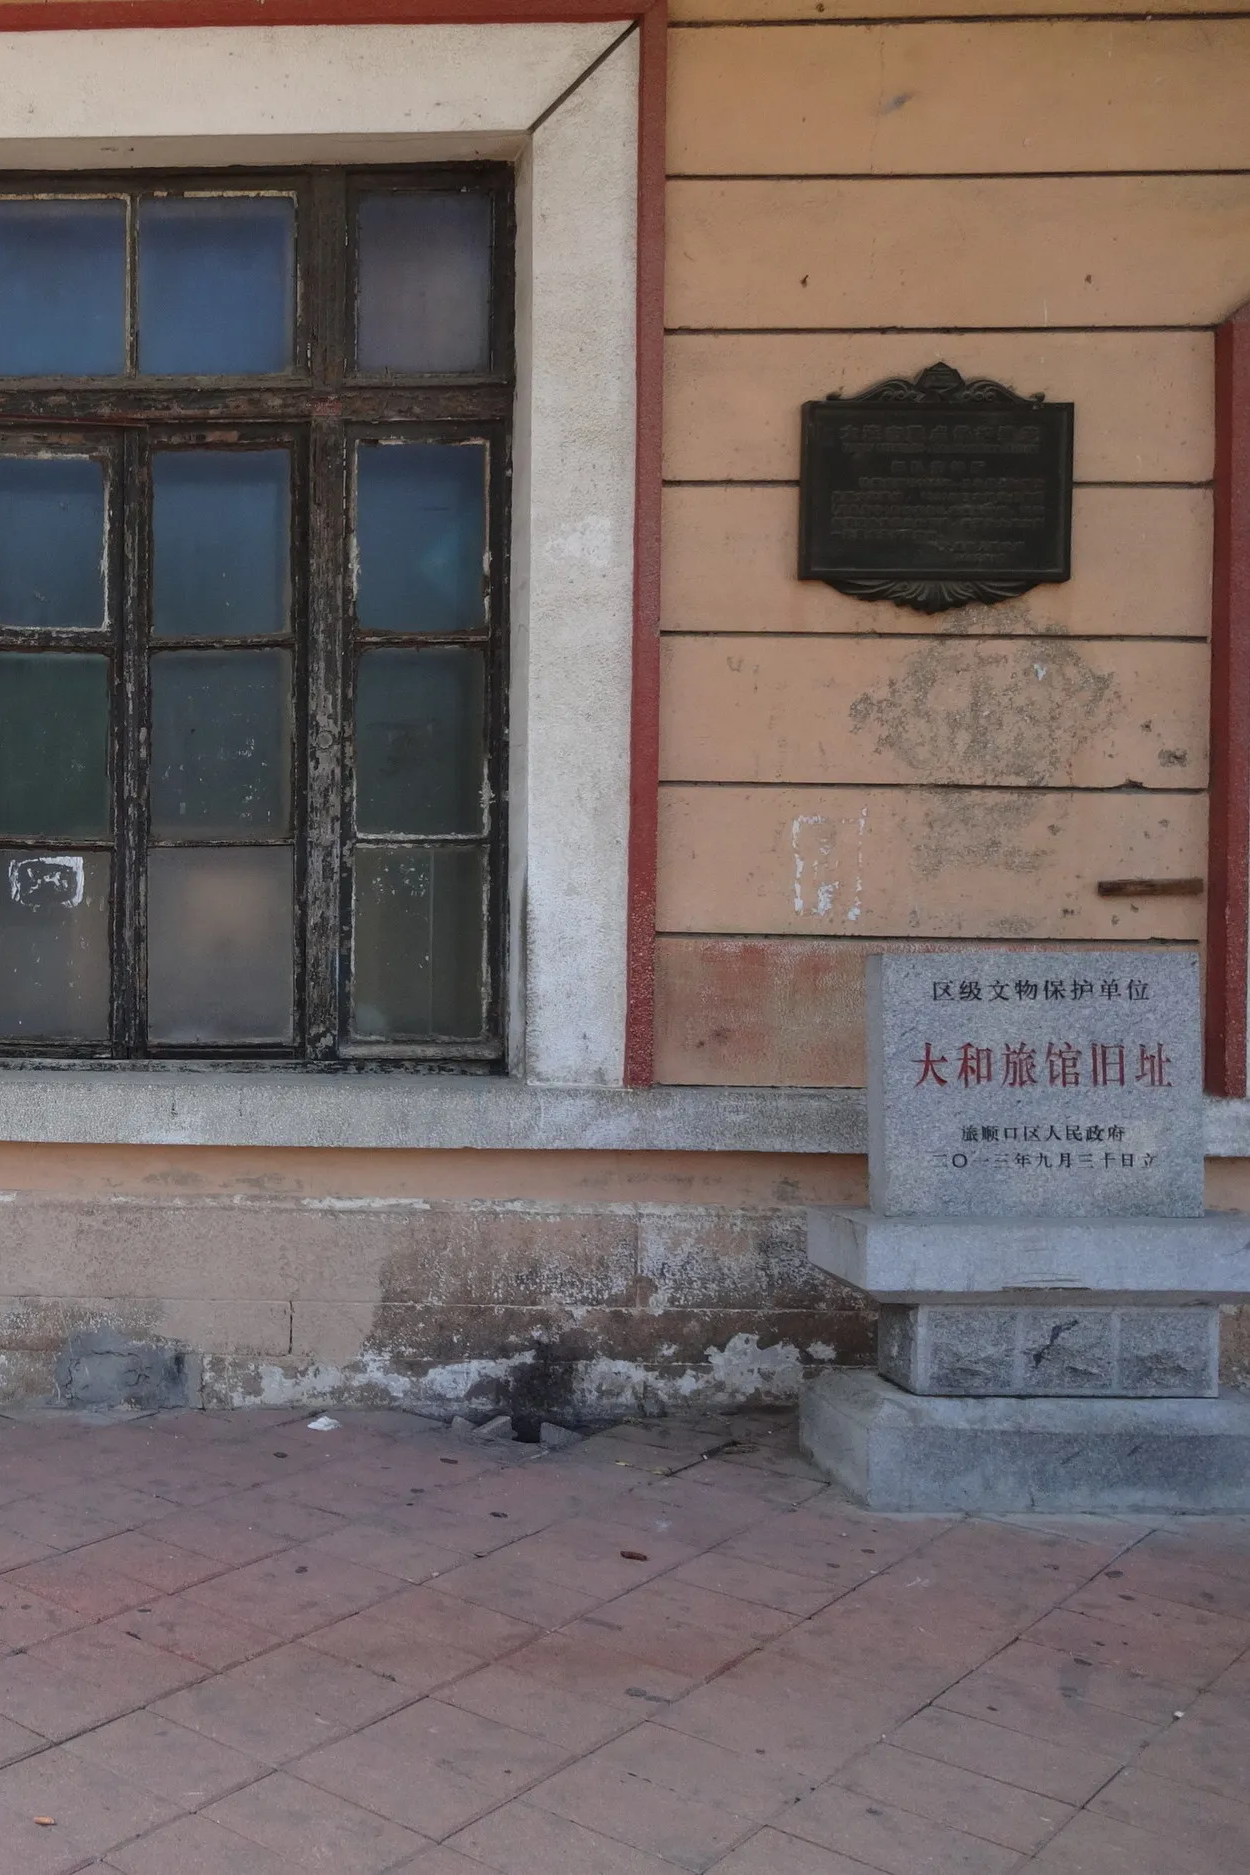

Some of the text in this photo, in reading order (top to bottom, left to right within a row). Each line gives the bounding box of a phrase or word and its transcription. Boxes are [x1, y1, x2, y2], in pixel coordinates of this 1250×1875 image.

[932, 979, 1150, 1002] 区级文物保护单位
[911, 1041, 1174, 1089] 大和旅馆旧址
[961, 1124, 1126, 1142] 旅顺口区人民政府
